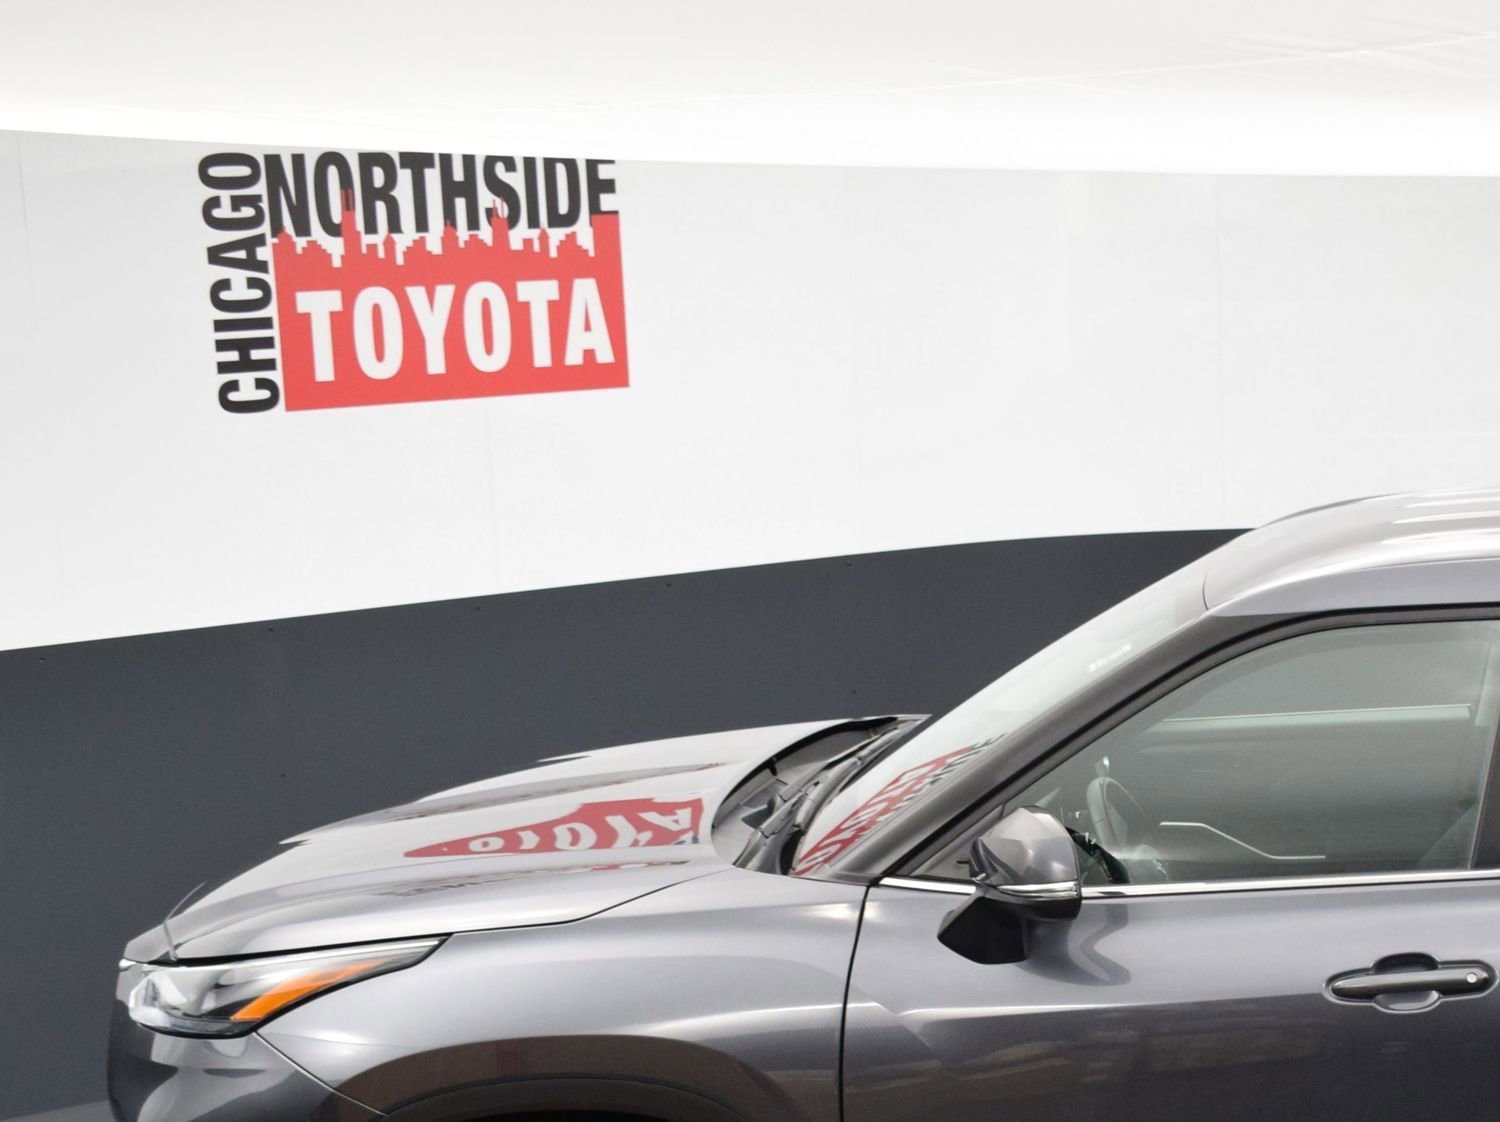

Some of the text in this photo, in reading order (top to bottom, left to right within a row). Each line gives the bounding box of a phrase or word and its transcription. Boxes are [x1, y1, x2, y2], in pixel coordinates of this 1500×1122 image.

[263, 151, 617, 238] NORTHSIDE
[198, 152, 280, 414] CHICAGO
[295, 278, 616, 383] TOYOTA
